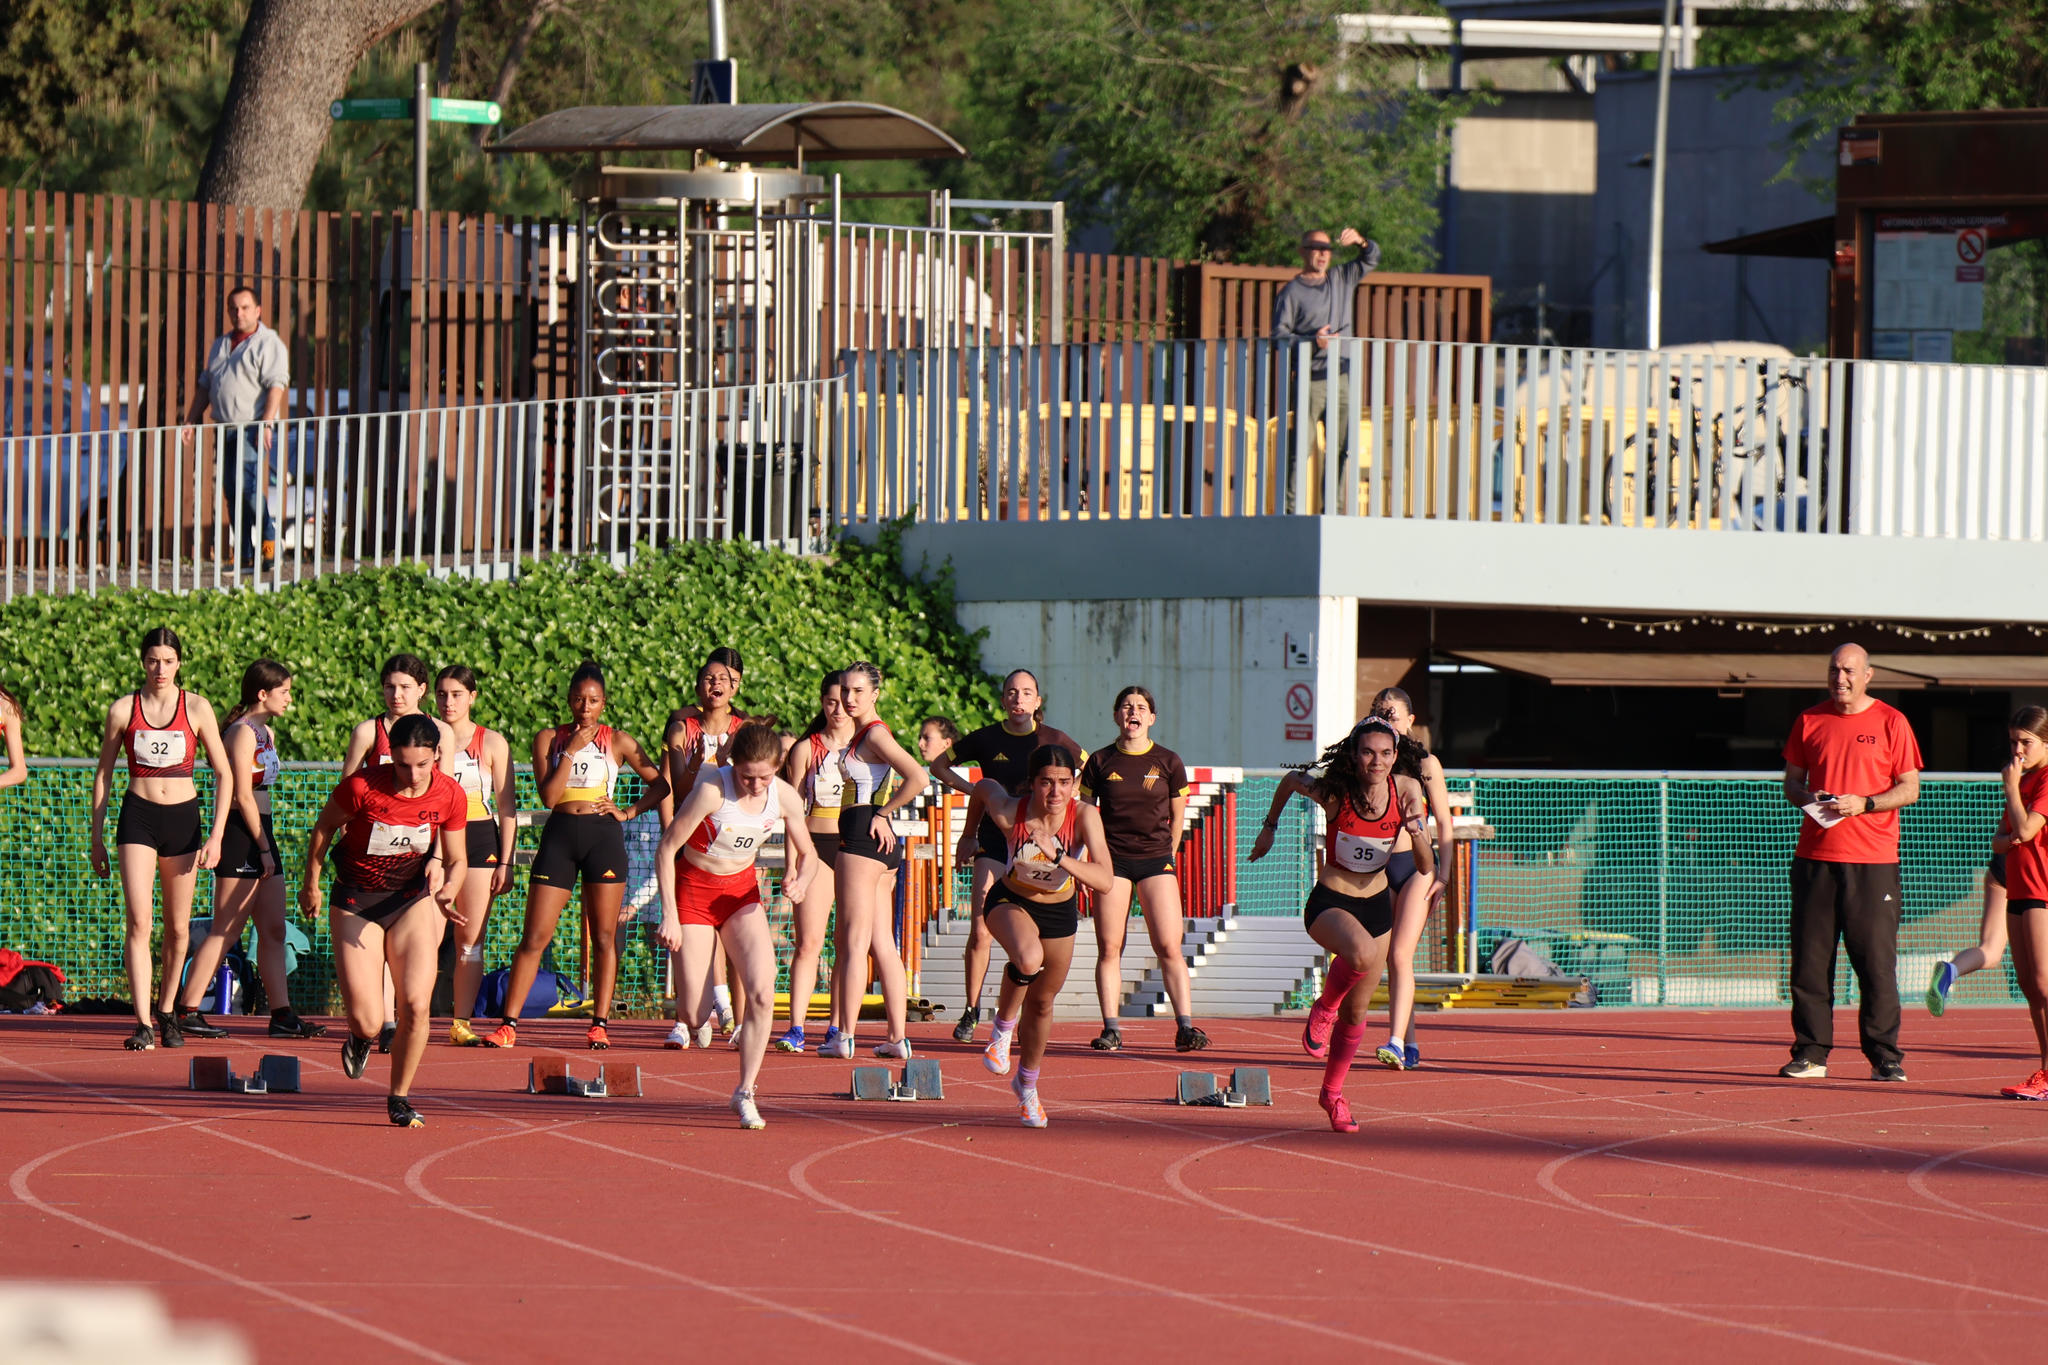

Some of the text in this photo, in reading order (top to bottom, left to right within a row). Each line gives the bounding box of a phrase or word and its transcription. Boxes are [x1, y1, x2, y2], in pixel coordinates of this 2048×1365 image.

[151, 742, 169, 755] 32
[573, 762, 589, 775] 19
[832, 784, 843, 796] 2
[389, 837, 411, 847] 40
[733, 836, 754, 848] 50
[1353, 847, 1375, 861] 35
[1032, 870, 1053, 881] 22
